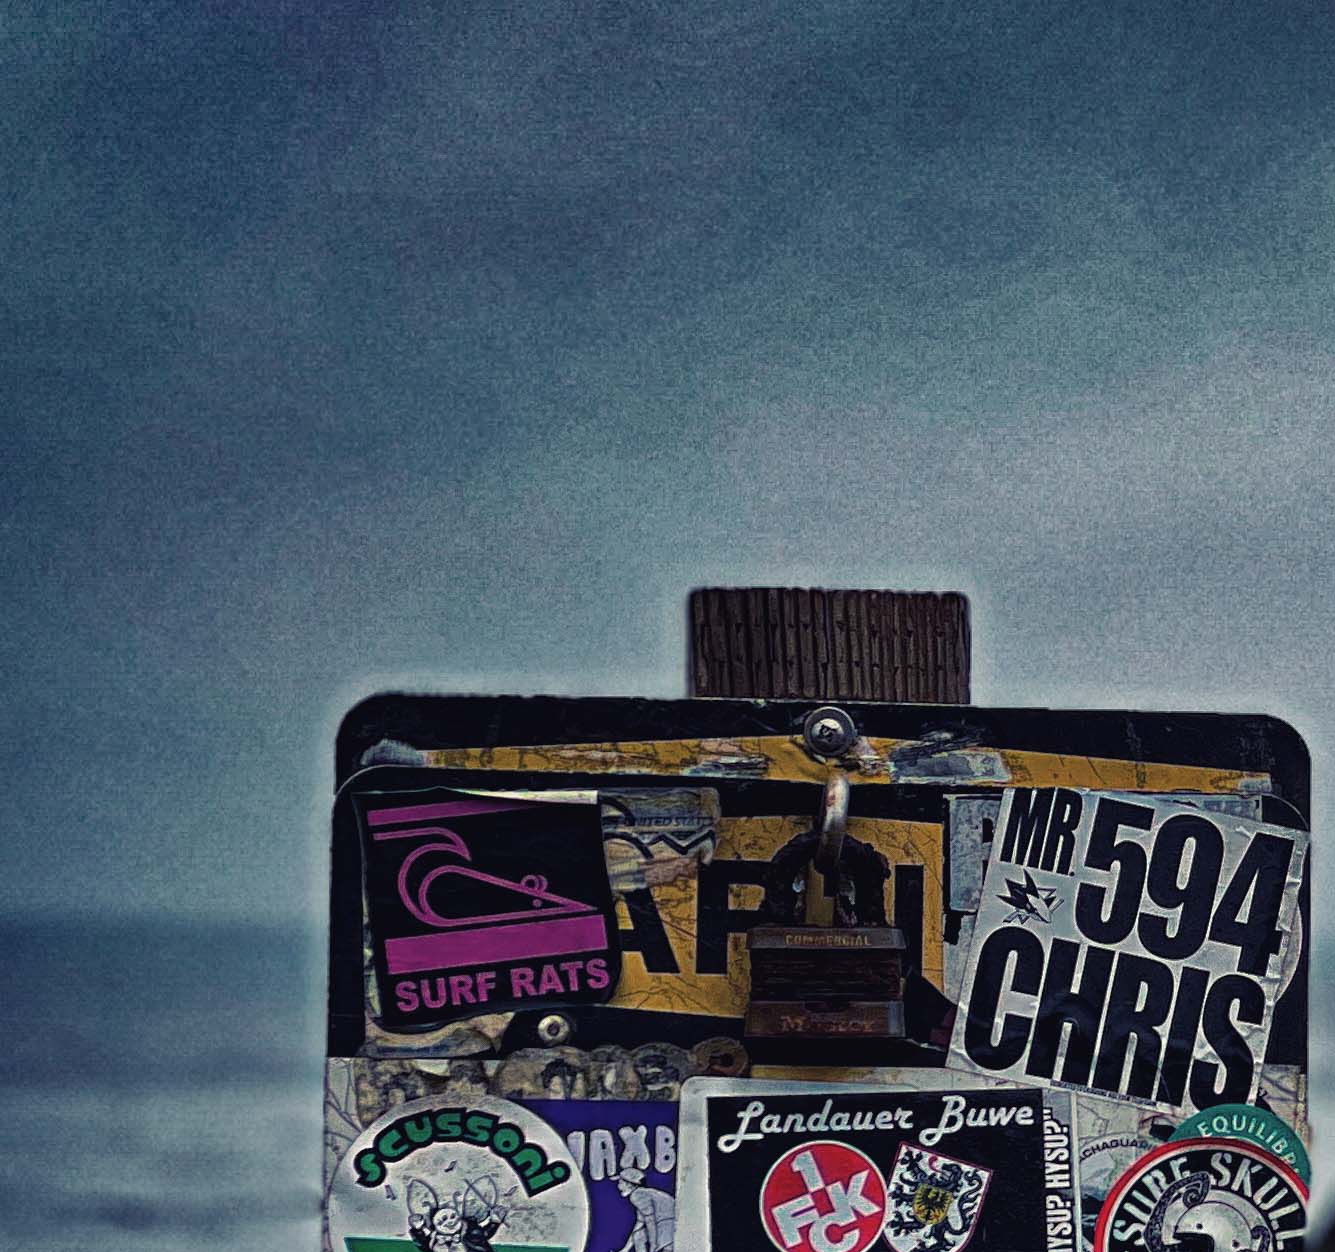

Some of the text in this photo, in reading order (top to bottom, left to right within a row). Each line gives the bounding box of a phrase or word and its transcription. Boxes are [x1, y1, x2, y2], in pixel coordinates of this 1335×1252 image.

[1074, 796, 1295, 977] 594
[395, 958, 611, 1012] SURF RATS
[964, 926, 1266, 1111] CHRIS
[717, 1095, 1036, 1153] Landauer Buwe
[1209, 1152, 1307, 1250] SKULL
